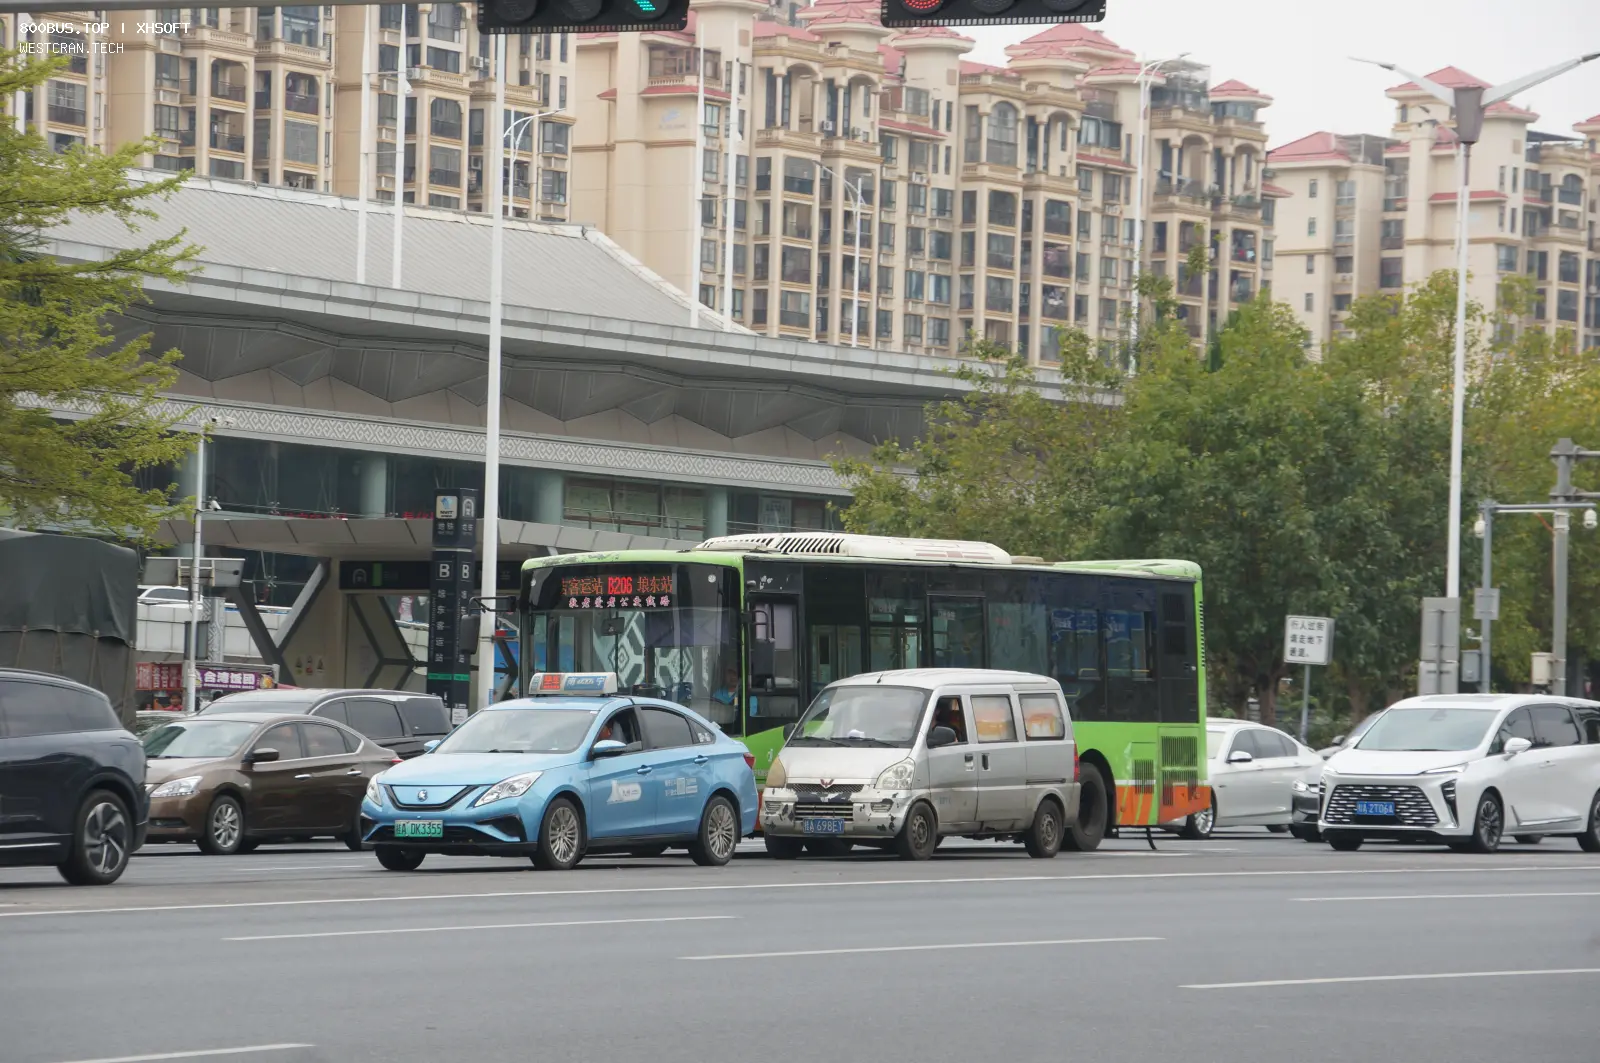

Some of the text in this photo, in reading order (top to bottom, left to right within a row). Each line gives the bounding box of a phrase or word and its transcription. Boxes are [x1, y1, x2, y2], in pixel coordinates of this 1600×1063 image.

[439, 563, 450, 578] B
[461, 564, 470, 579] B
[608, 576, 633, 595] B206
[1290, 620, 1325, 631] 行人过街
[203, 670, 256, 686] 台湾饭团
